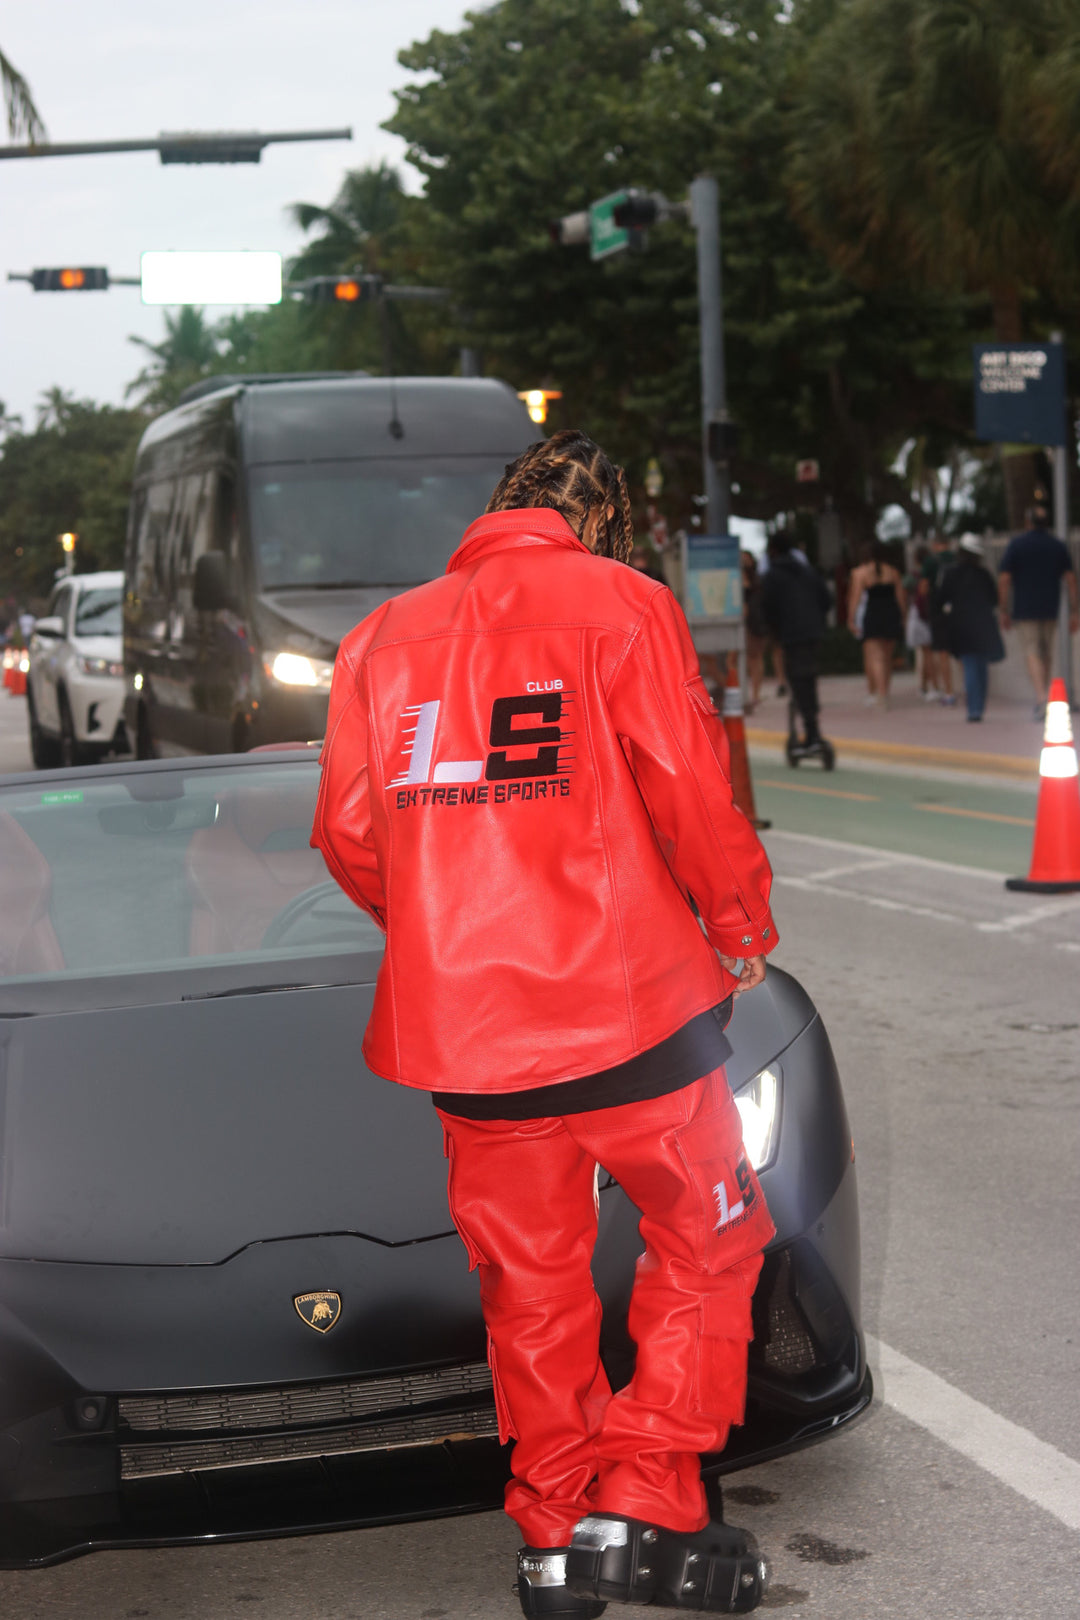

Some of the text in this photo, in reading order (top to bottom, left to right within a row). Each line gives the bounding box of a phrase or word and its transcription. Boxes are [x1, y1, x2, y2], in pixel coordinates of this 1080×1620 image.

[526, 679, 564, 693] CLUB
[386, 691, 576, 790] LS
[397, 778, 570, 810] EXTREME SPORTS
